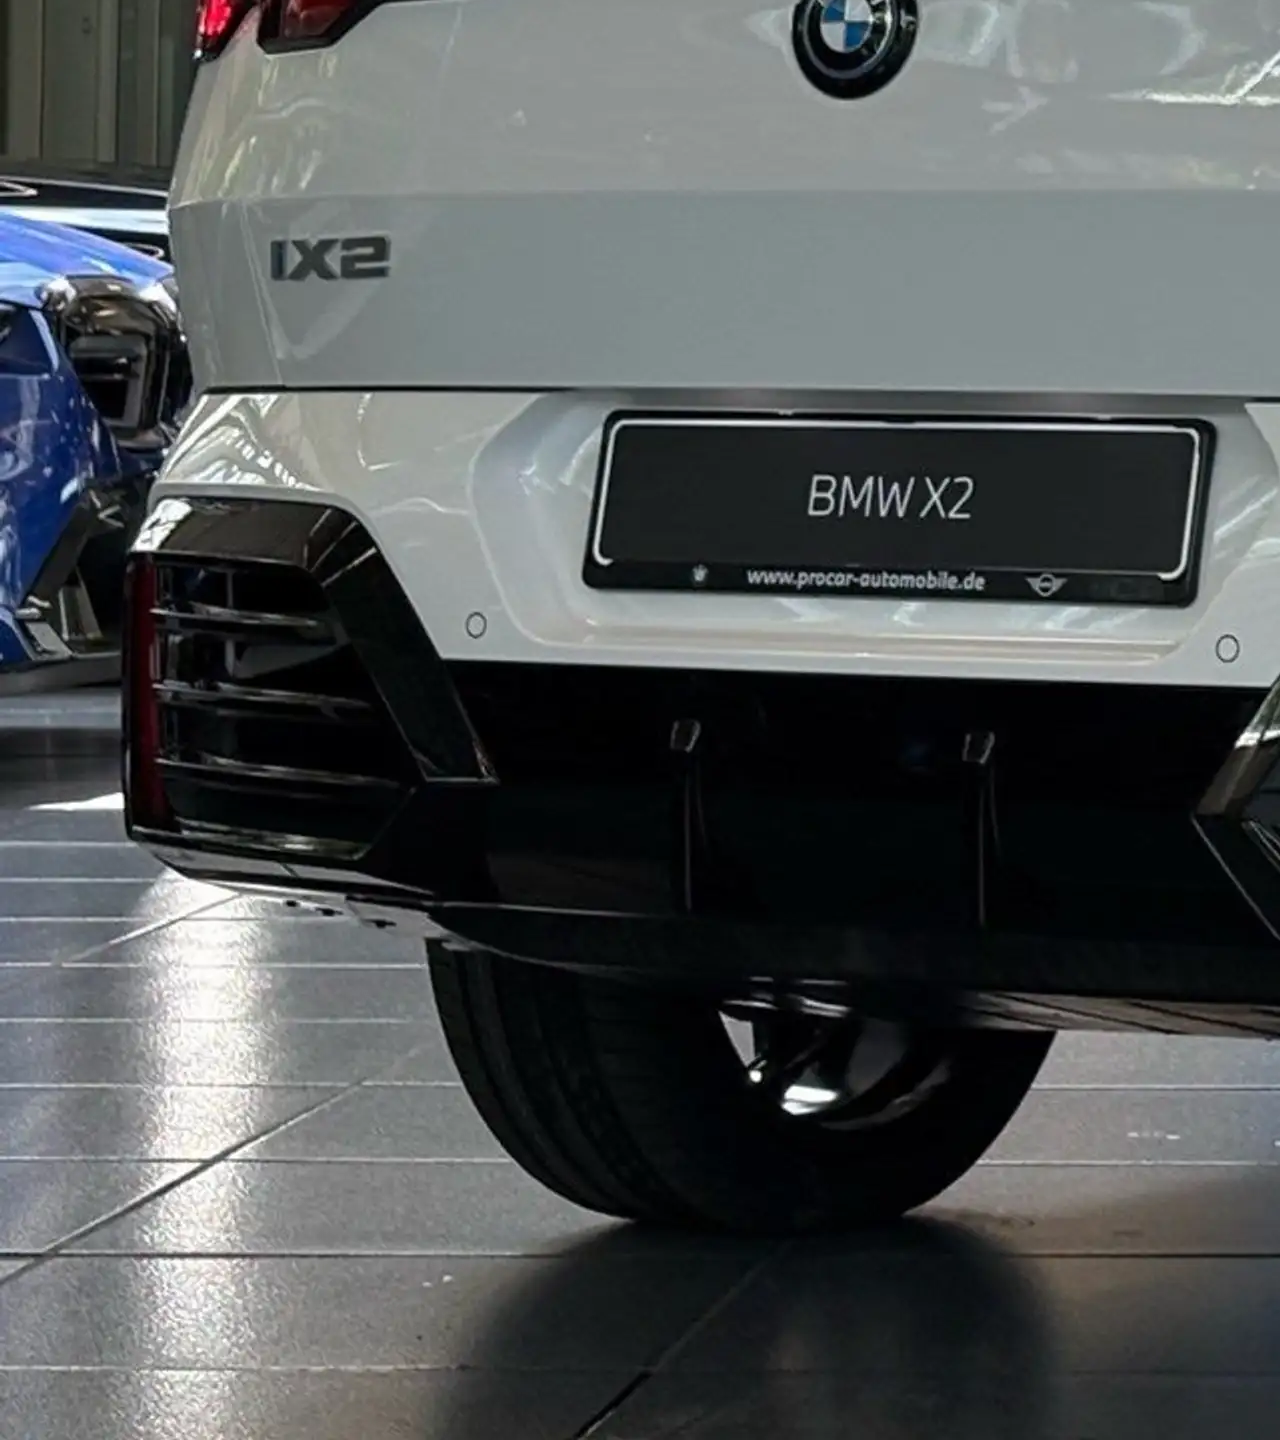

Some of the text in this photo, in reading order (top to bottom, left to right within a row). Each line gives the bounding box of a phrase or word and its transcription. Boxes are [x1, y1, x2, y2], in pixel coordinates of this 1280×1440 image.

[807, 474, 974, 519] BMW X2
[746, 569, 986, 591] www.procar-automobile.de
